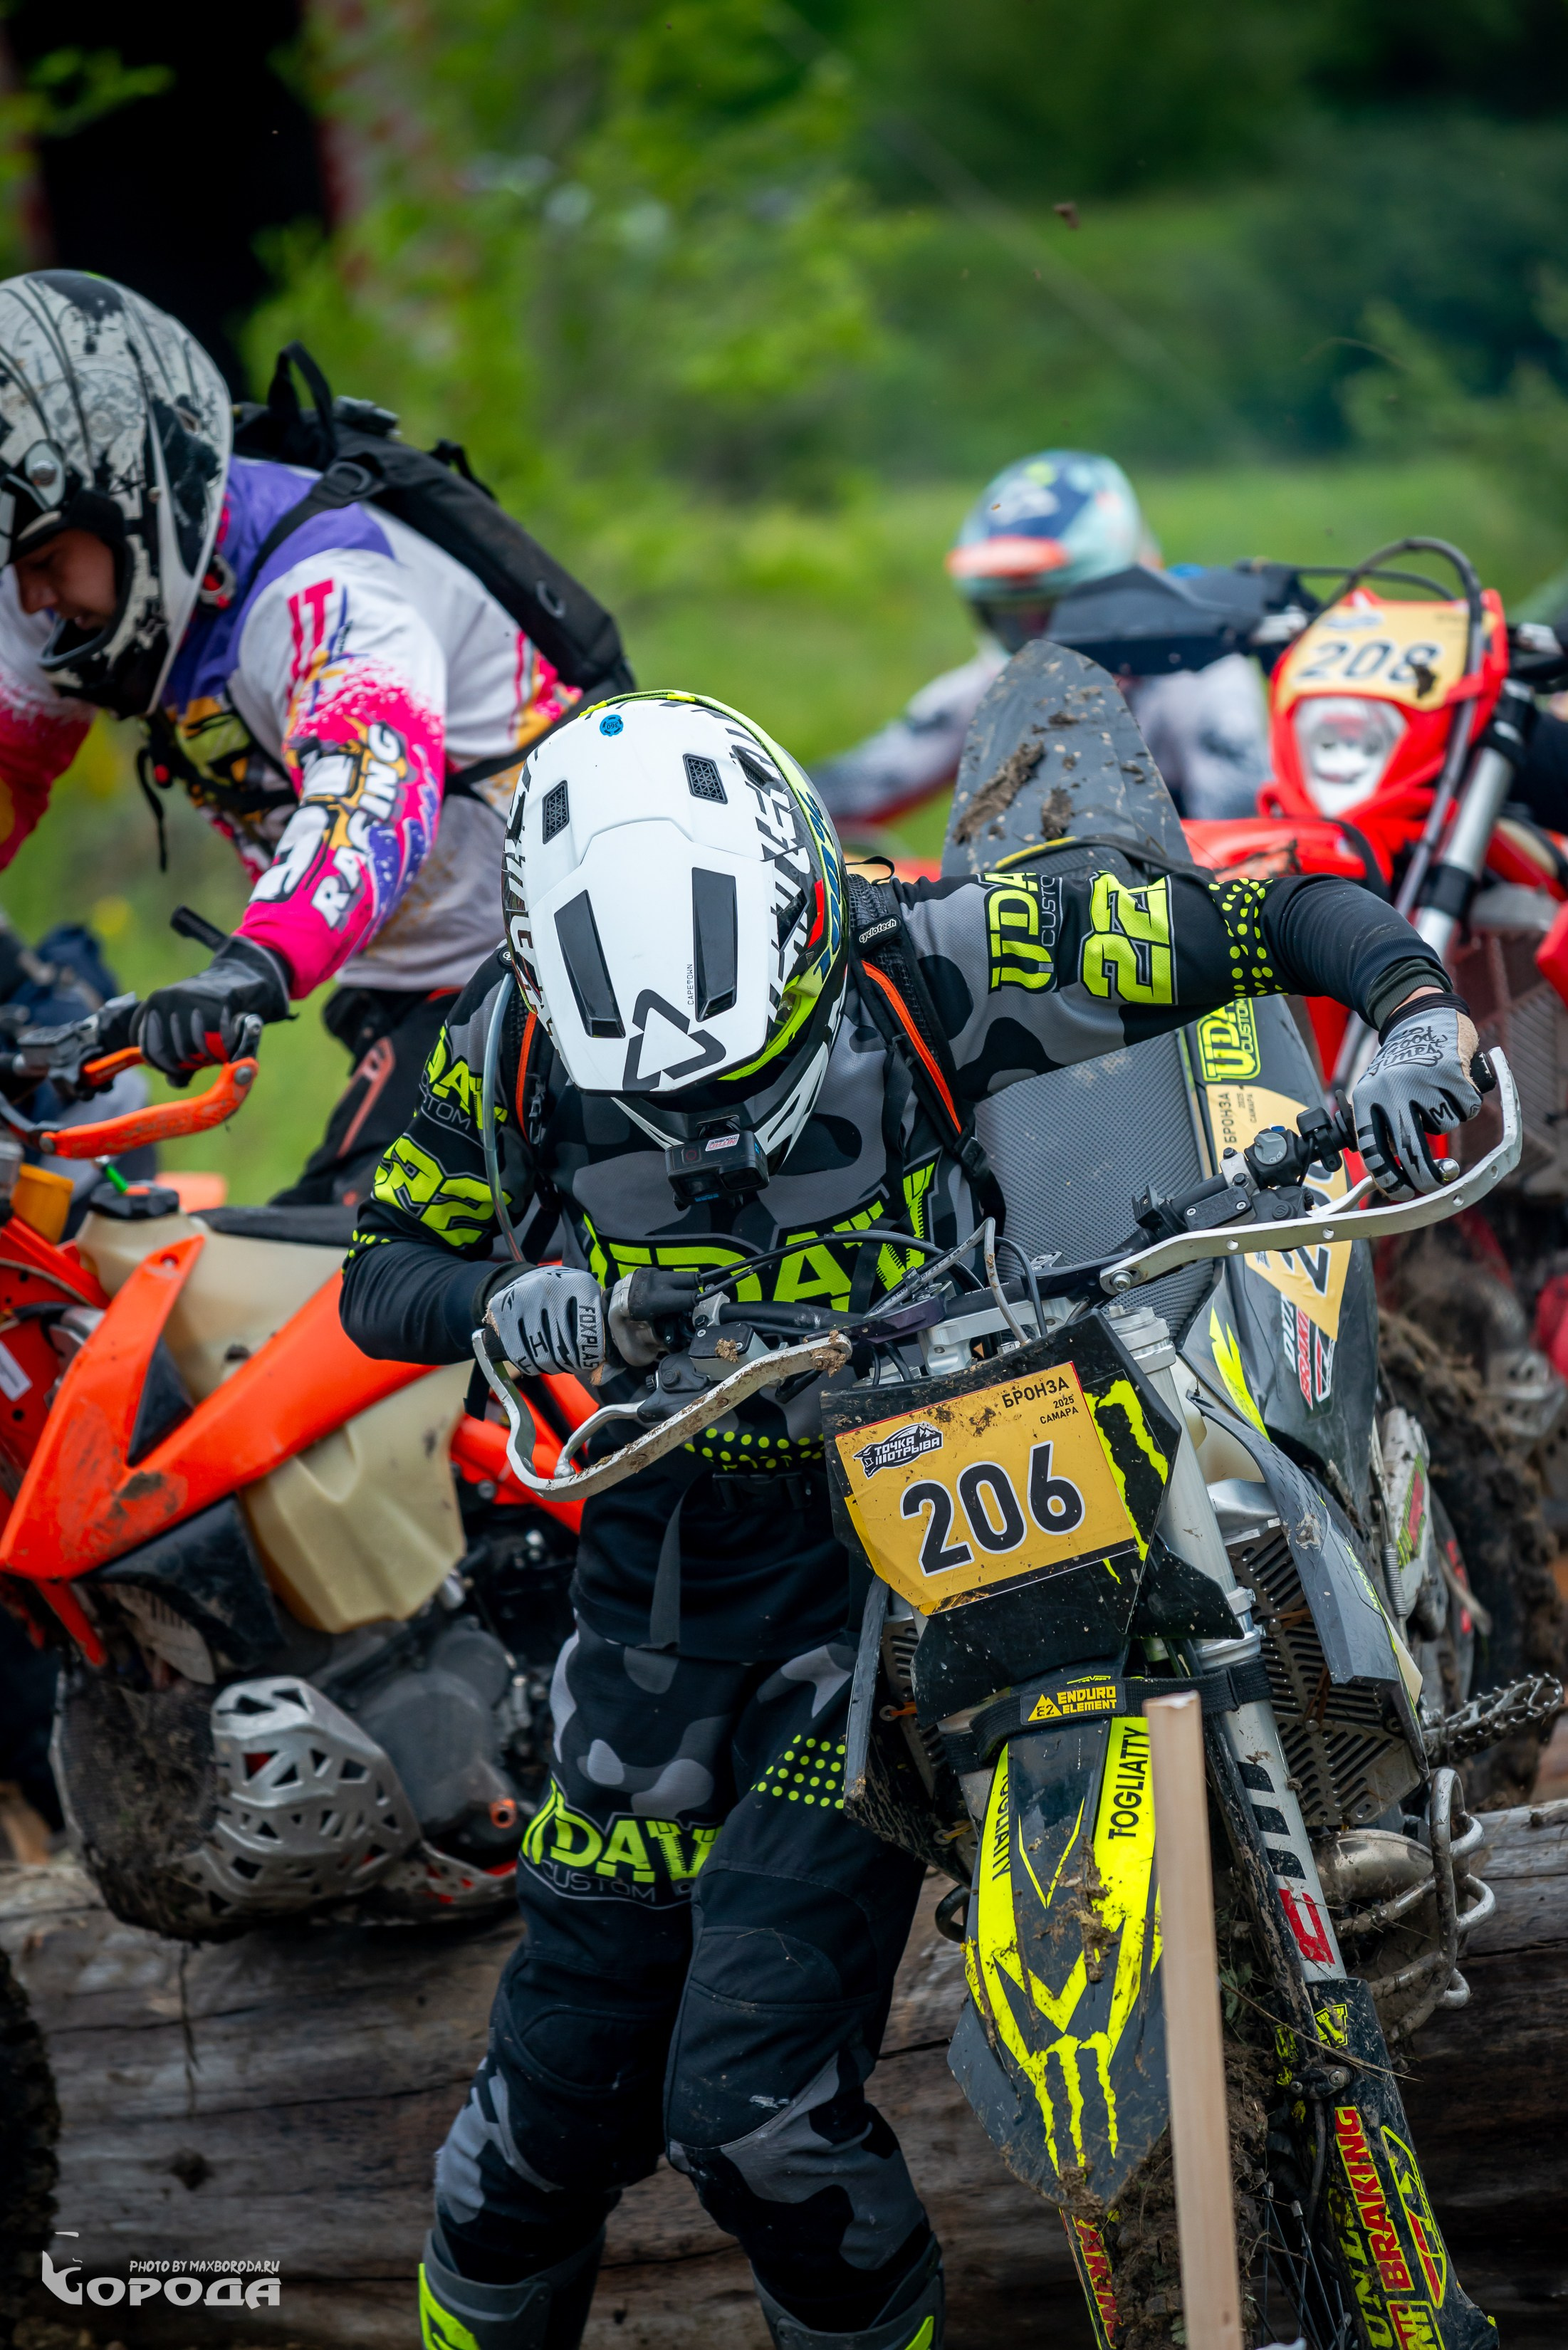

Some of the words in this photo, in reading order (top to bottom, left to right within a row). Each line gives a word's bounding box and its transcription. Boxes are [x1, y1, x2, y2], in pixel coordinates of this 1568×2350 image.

[1296, 639, 1438, 682] 208
[310, 721, 402, 928] RACING
[859, 919, 897, 944] cyclotech
[1083, 870, 1174, 1004] 22
[1218, 1092, 1237, 1143] БРОНЗА
[1002, 1377, 1070, 1409] БРОНЗА
[1053, 1396, 1075, 1409] 2025
[1040, 1406, 1079, 1424] САМАРА
[874, 1436, 915, 1456] ТОЧКА
[901, 1440, 1085, 1577] 206
[1057, 1686, 1117, 1705] ENDURO
[1062, 1699, 1117, 1715] ELEMENT
[1108, 1725, 1151, 1840] TOGLIATTY
[540, 1859, 656, 1902] CUSTOM
[1334, 2106, 1416, 2292] BRAKING
